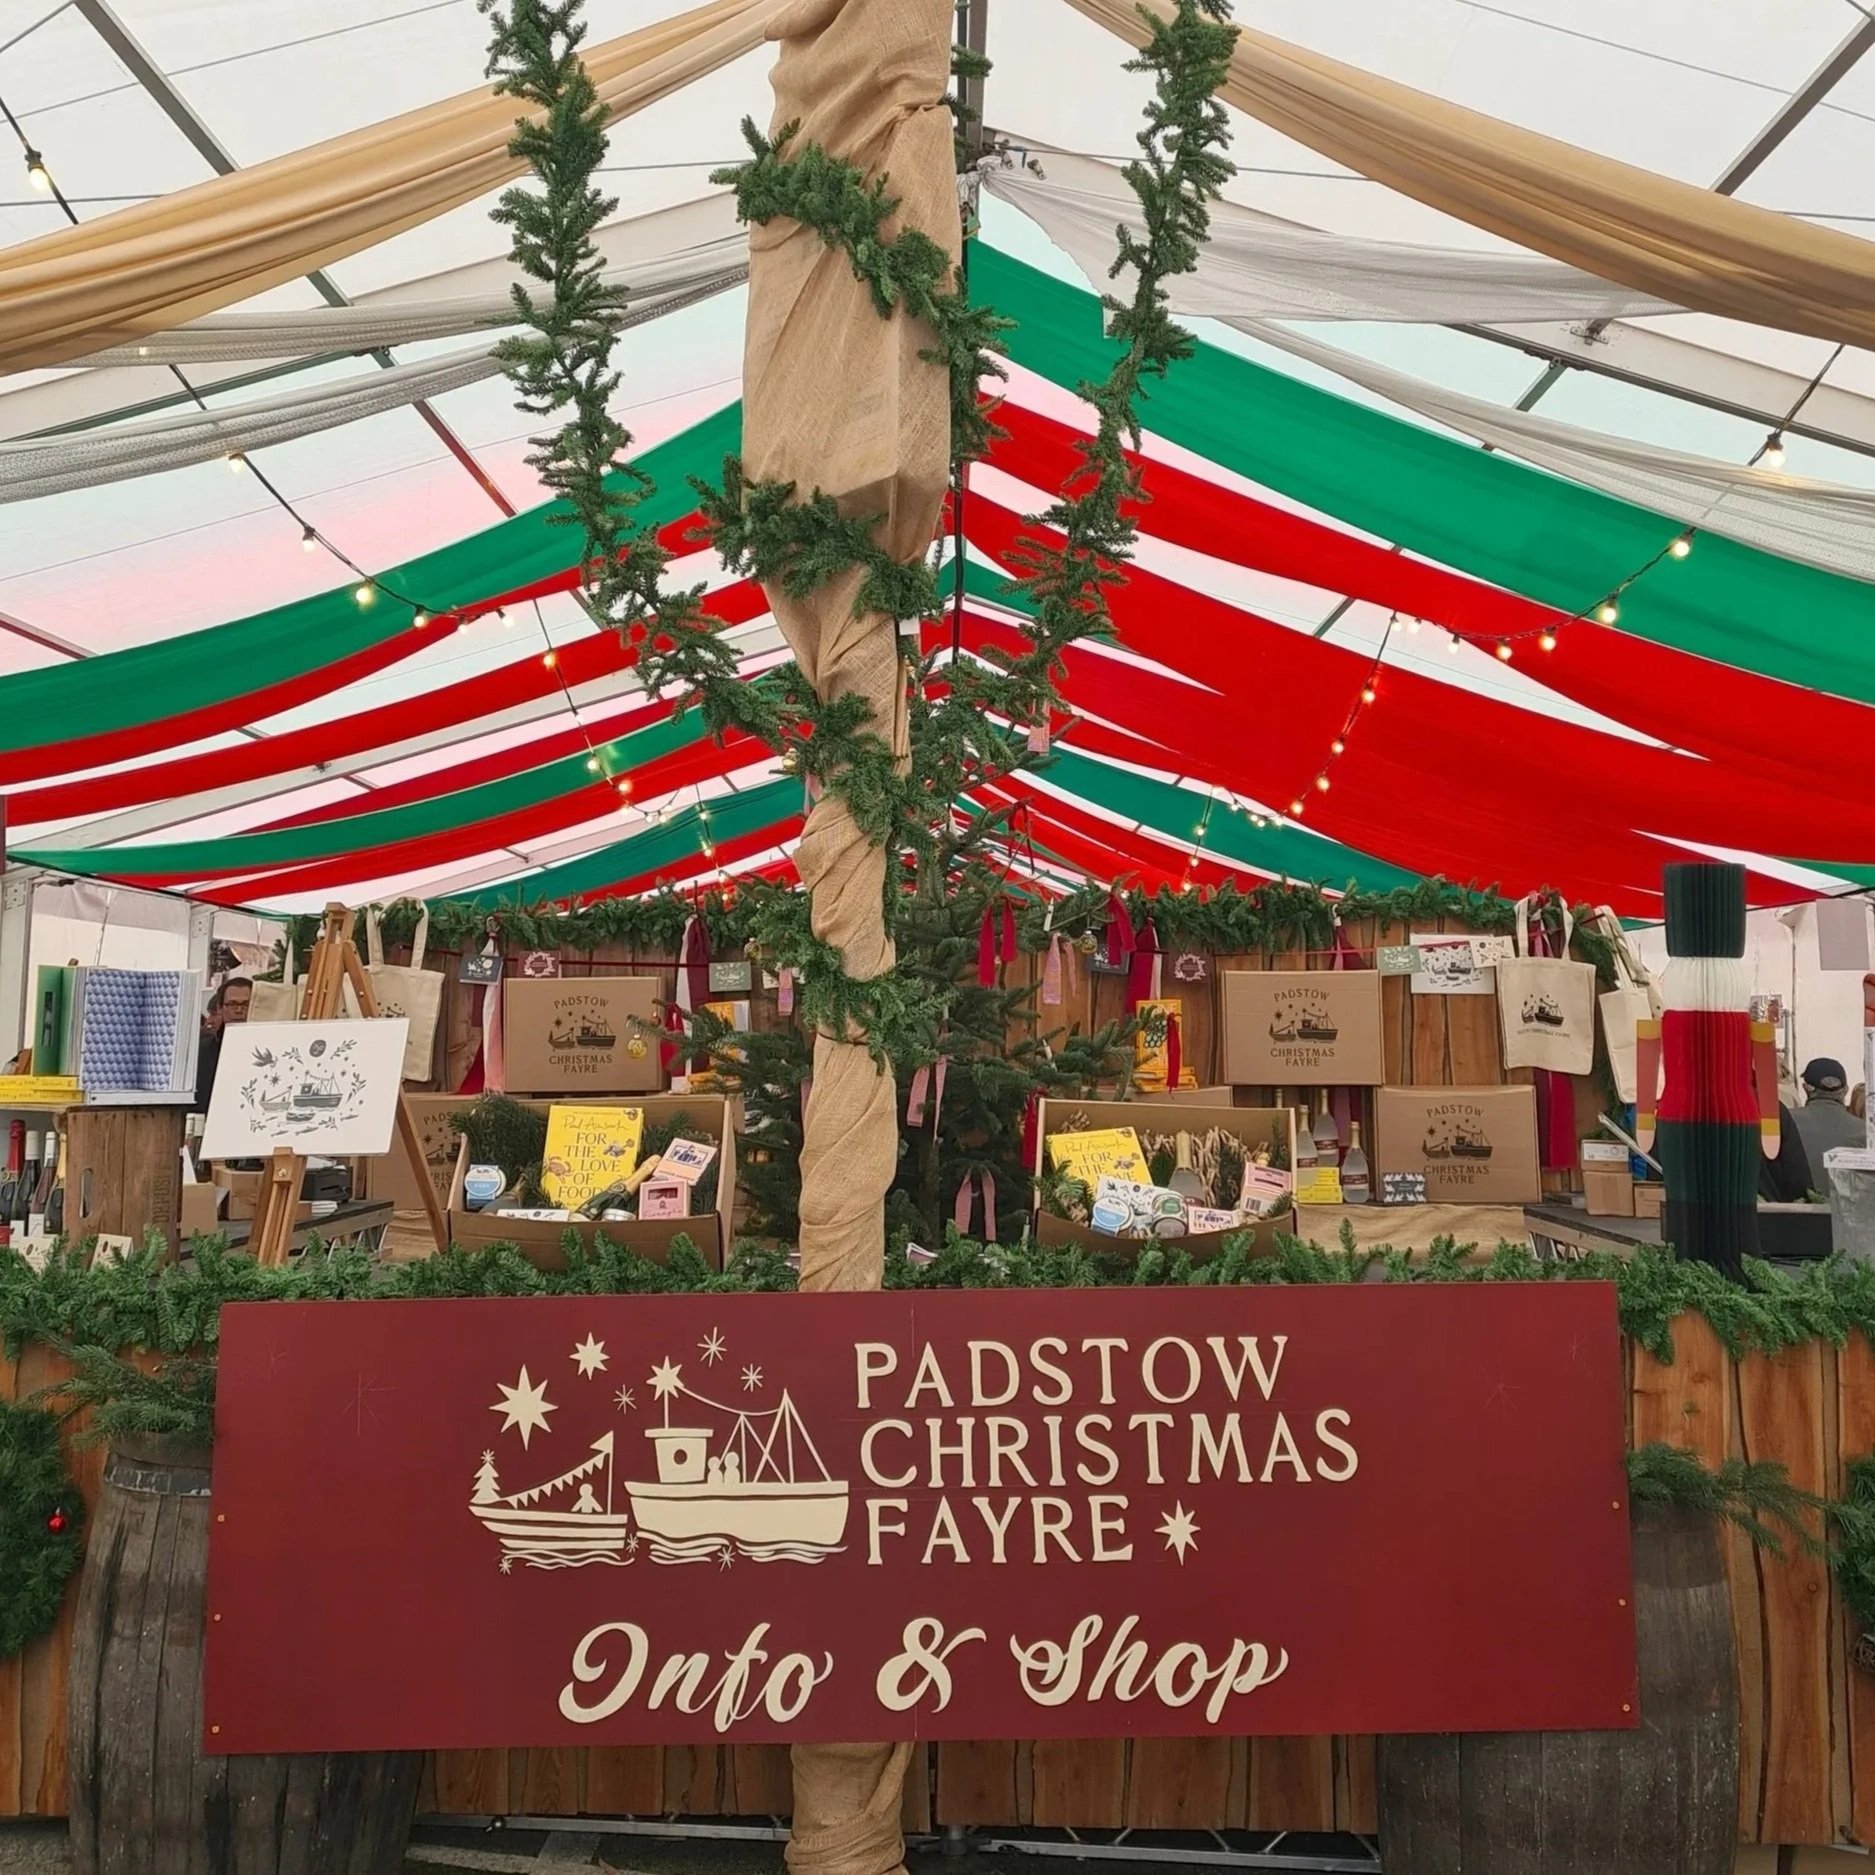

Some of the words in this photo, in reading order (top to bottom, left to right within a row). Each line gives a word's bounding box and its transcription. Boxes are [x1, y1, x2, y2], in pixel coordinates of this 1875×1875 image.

[1273, 988, 1330, 1002] PADSTOW
[553, 995, 609, 1010] PADSTOW
[549, 1054, 613, 1065] CHRISTMAS
[1270, 1047, 1335, 1058] CHRISTMAS
[563, 1064, 599, 1074] FAYRE
[1285, 1057, 1320, 1067] FAYRE
[1426, 1104, 1484, 1118] PADSTOW
[575, 1131, 607, 1145] FOR
[564, 1144, 597, 1159] THE
[1082, 1151, 1114, 1165] FOR
[580, 1159, 622, 1173] LOVE
[1075, 1162, 1109, 1177] THE
[1423, 1164, 1490, 1176] CHRISTMAS
[572, 1172, 595, 1186] OF
[1439, 1175, 1475, 1185] FAYRE
[854, 1335, 1289, 1410] PADSTOW
[859, 1408, 1360, 1489] CHRISTMAS
[866, 1494, 1134, 1567] FAYRE
[558, 1622, 834, 1733] Info
[875, 1617, 986, 1714] &
[1009, 1614, 1290, 1723] Shop
